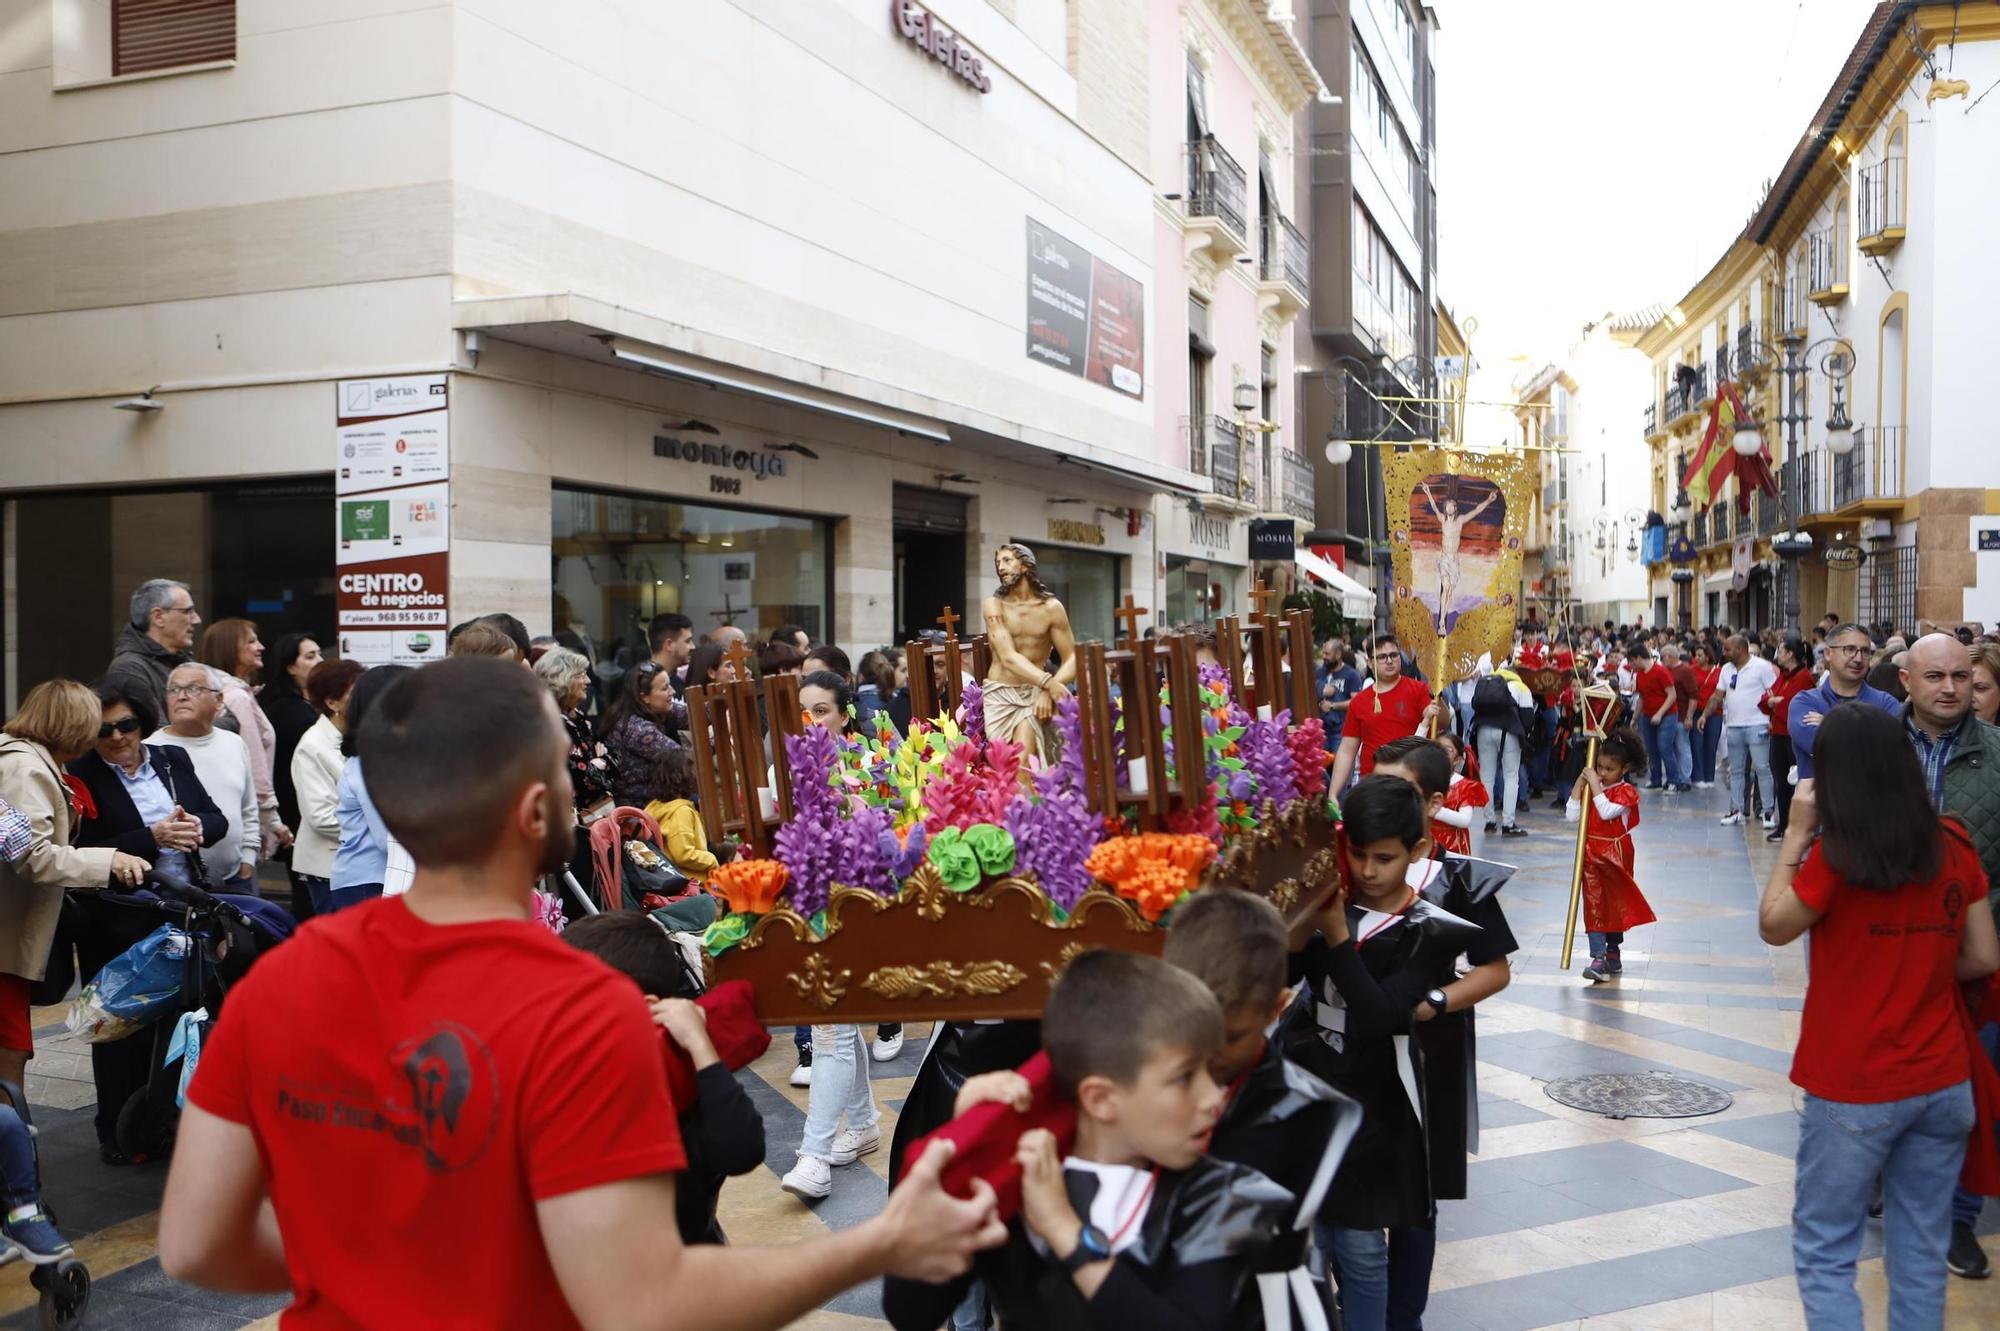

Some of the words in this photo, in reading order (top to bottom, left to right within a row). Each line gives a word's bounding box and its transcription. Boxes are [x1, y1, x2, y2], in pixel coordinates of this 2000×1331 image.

[653, 434, 787, 481] montoya
[710, 474, 741, 495] 1903
[339, 572, 424, 593] CENTRO
[361, 591, 380, 606] de
[381, 590, 444, 609] negocios
[352, 615, 374, 623] planta
[377, 612, 397, 622] 968
[398, 612, 411, 622] 95
[412, 612, 426, 622] 96
[427, 612, 440, 622] 87
